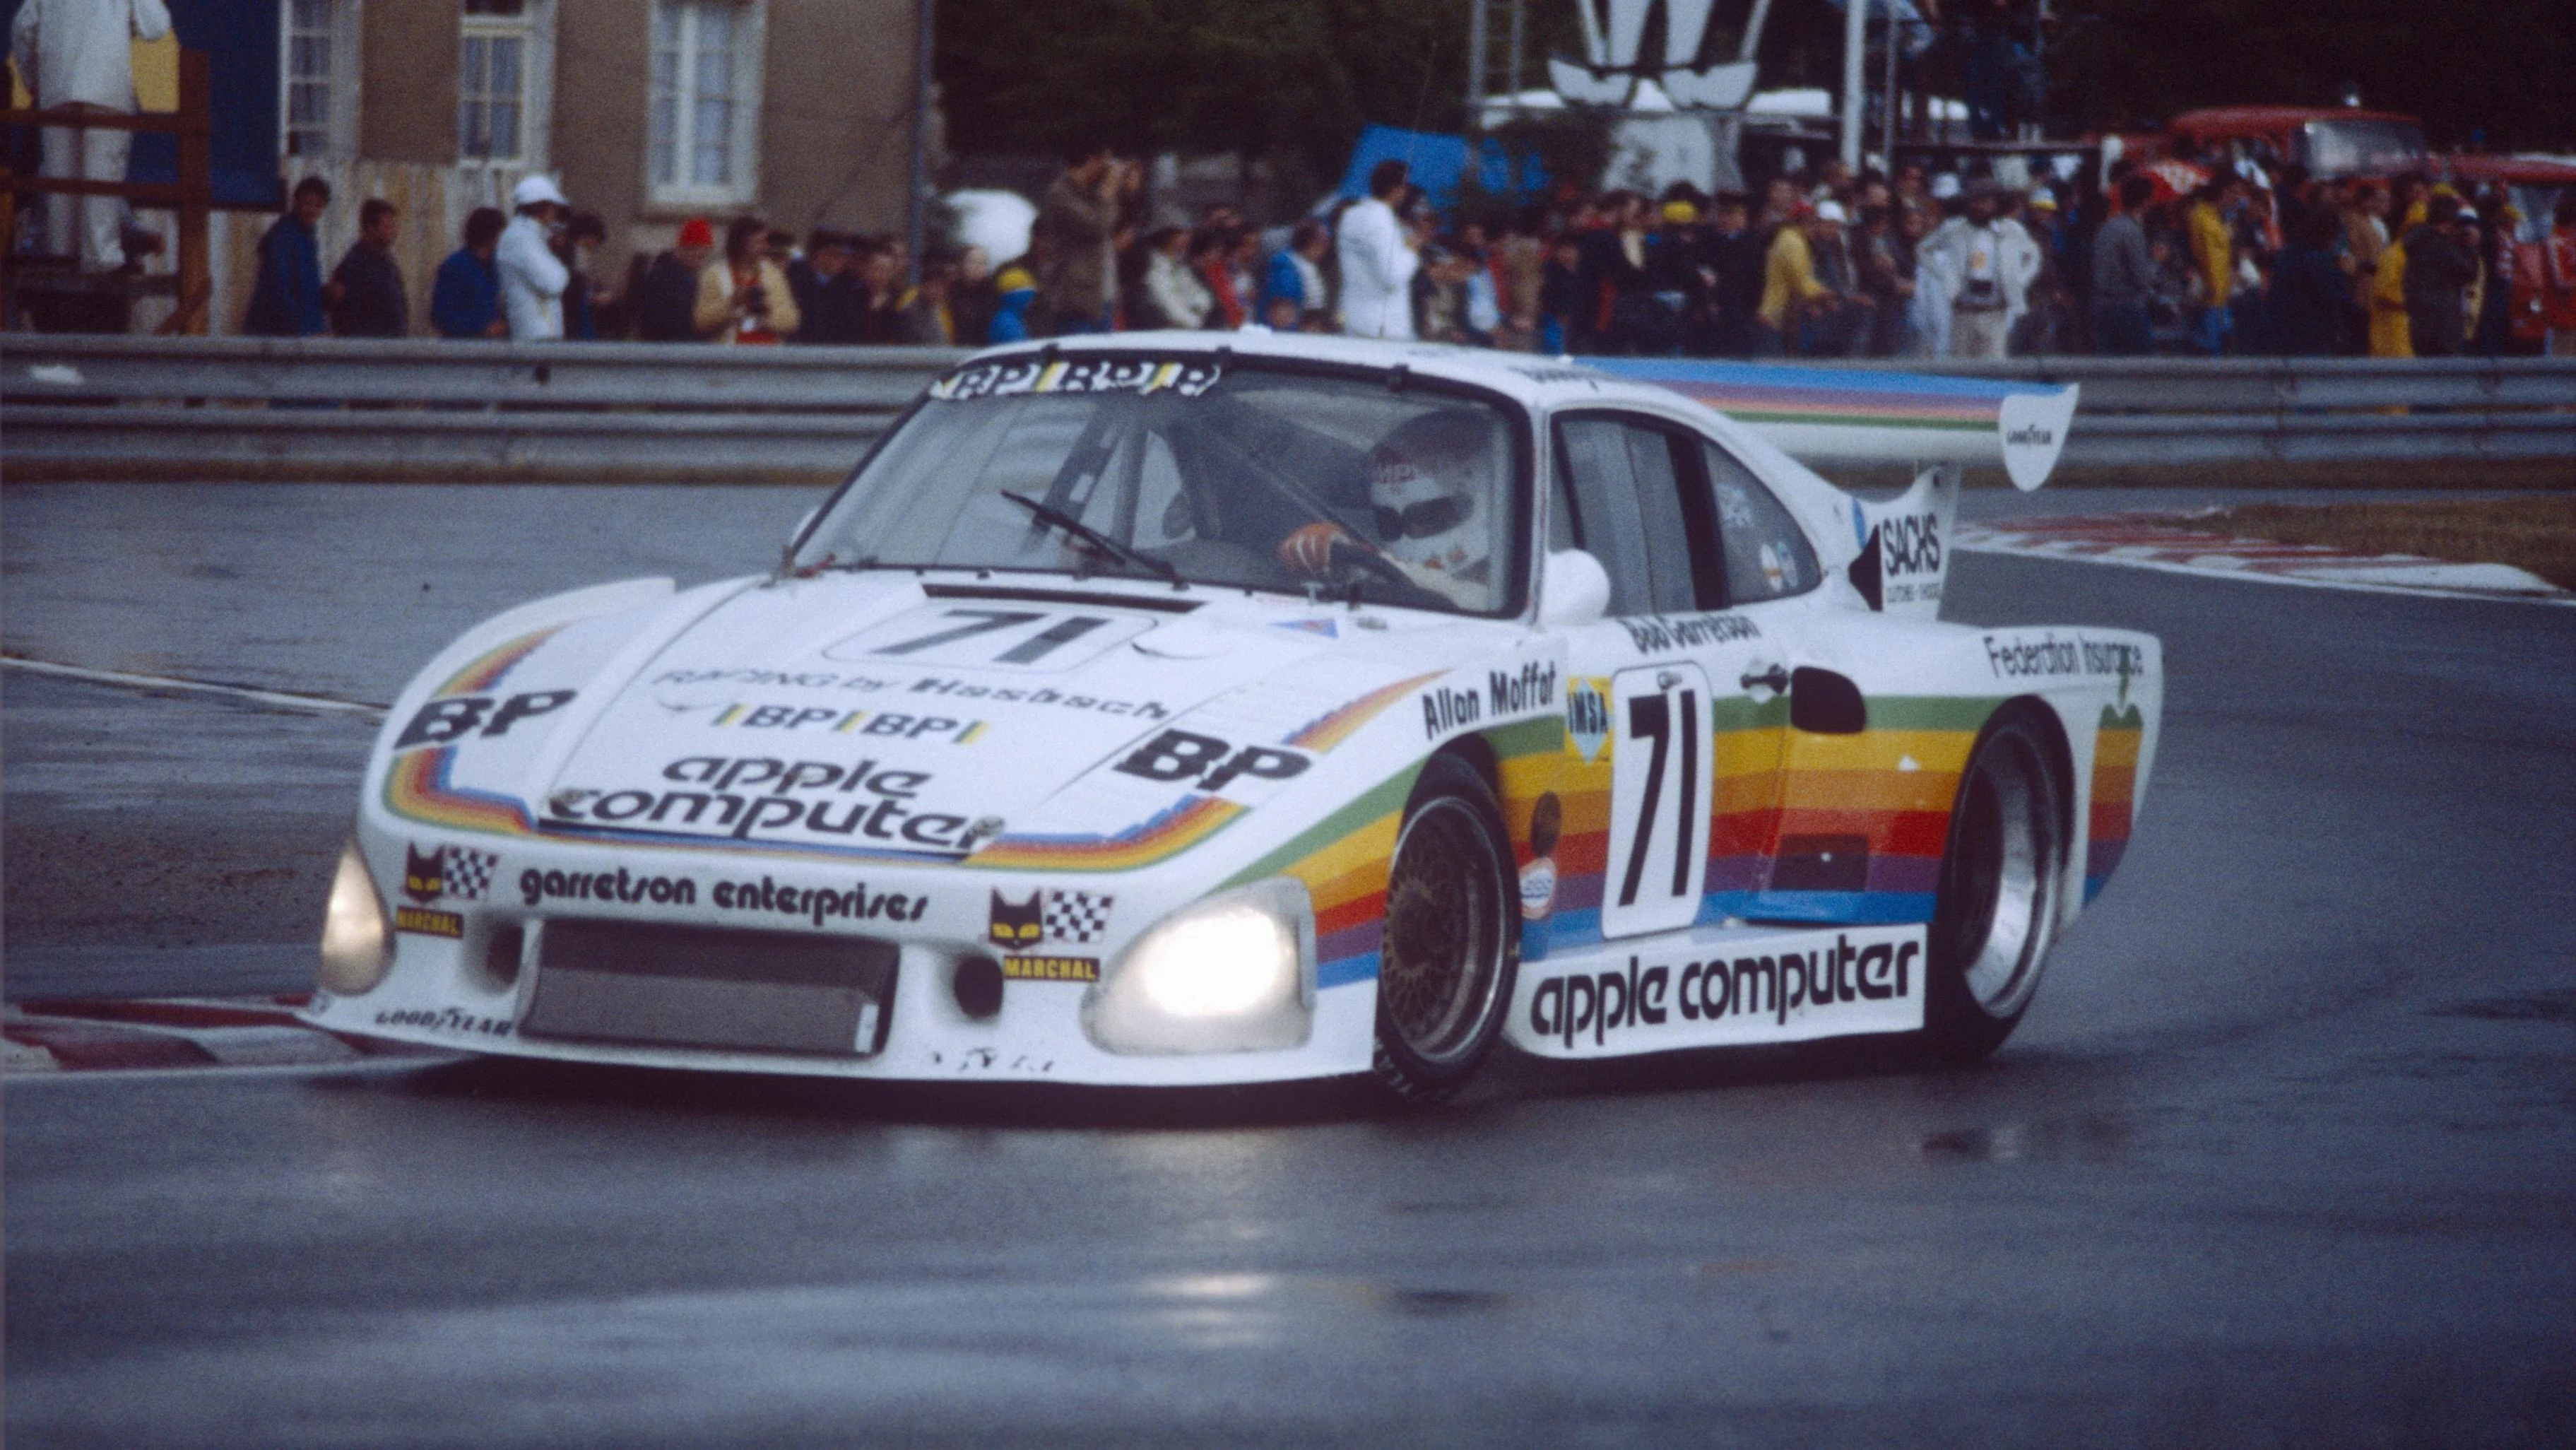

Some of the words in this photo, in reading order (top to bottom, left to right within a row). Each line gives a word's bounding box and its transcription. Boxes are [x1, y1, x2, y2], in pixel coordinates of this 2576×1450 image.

[1882, 512, 1941, 577] SACHS
[868, 608, 1113, 664] 71
[394, 689, 577, 750] BP
[742, 705, 837, 730] BP
[861, 712, 959, 739] BP
[1422, 684, 1480, 742] Allan
[1488, 660, 1556, 717] Moffat
[1566, 690, 1609, 734] IMSA
[662, 755, 933, 799] apple
[1111, 729, 1312, 792] BP
[549, 786, 987, 849] computer
[1619, 688, 1696, 907] 71
[519, 867, 697, 907] garretson
[711, 876, 929, 927] enterprises
[1004, 957, 1097, 980] MARCHAL
[1530, 955, 1670, 1049] apple
[1679, 933, 1920, 1025] computer
